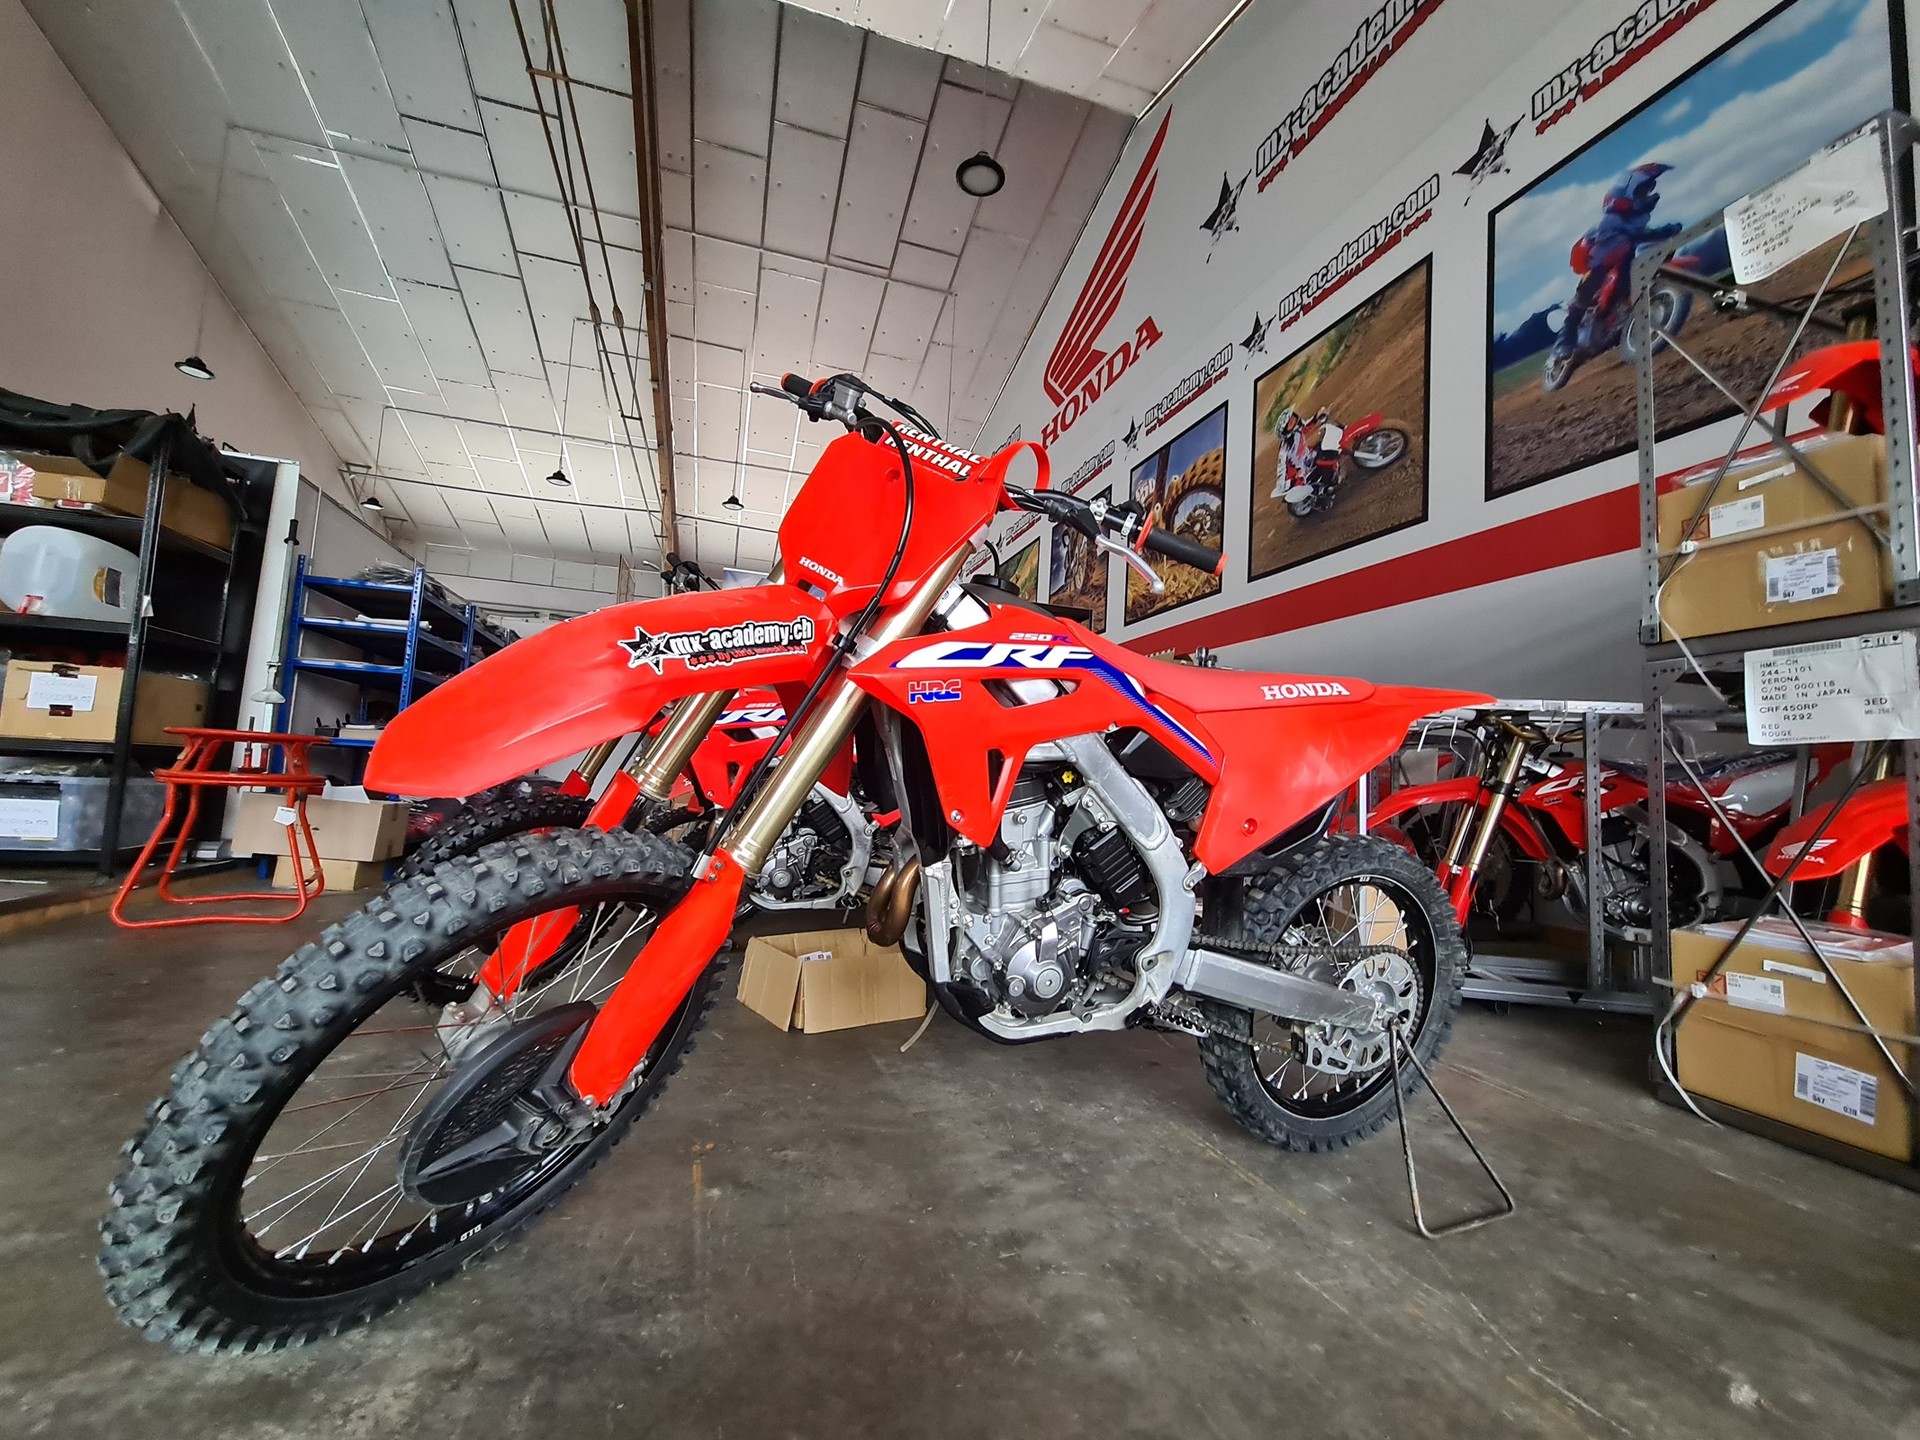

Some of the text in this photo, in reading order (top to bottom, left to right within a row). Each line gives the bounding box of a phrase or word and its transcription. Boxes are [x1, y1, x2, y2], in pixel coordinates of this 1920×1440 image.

[1279, 173, 1440, 321] mx-academy.com
[1041, 316, 1164, 451] HONDA
[1144, 342, 1233, 428] mx-academy.com
[895, 421, 982, 464] RENTHAL
[798, 556, 844, 588] HONDA
[668, 616, 814, 656] mx-academy.ch
[1008, 632, 1073, 644] 250R
[895, 641, 1095, 669] CRF
[1761, 665, 1812, 677] 244-1101
[1761, 675, 1800, 685] VERONA
[908, 678, 962, 704] HRC
[1260, 682, 1351, 701] HONDA
[1761, 684, 1788, 694] C/NO
[1761, 693, 1788, 701] MADE
[1816, 688, 1851, 697] JAPAN
[1759, 702, 1818, 714] CRF450RP
[1864, 697, 1888, 706] 3ED
[1783, 712, 1813, 721] R292
